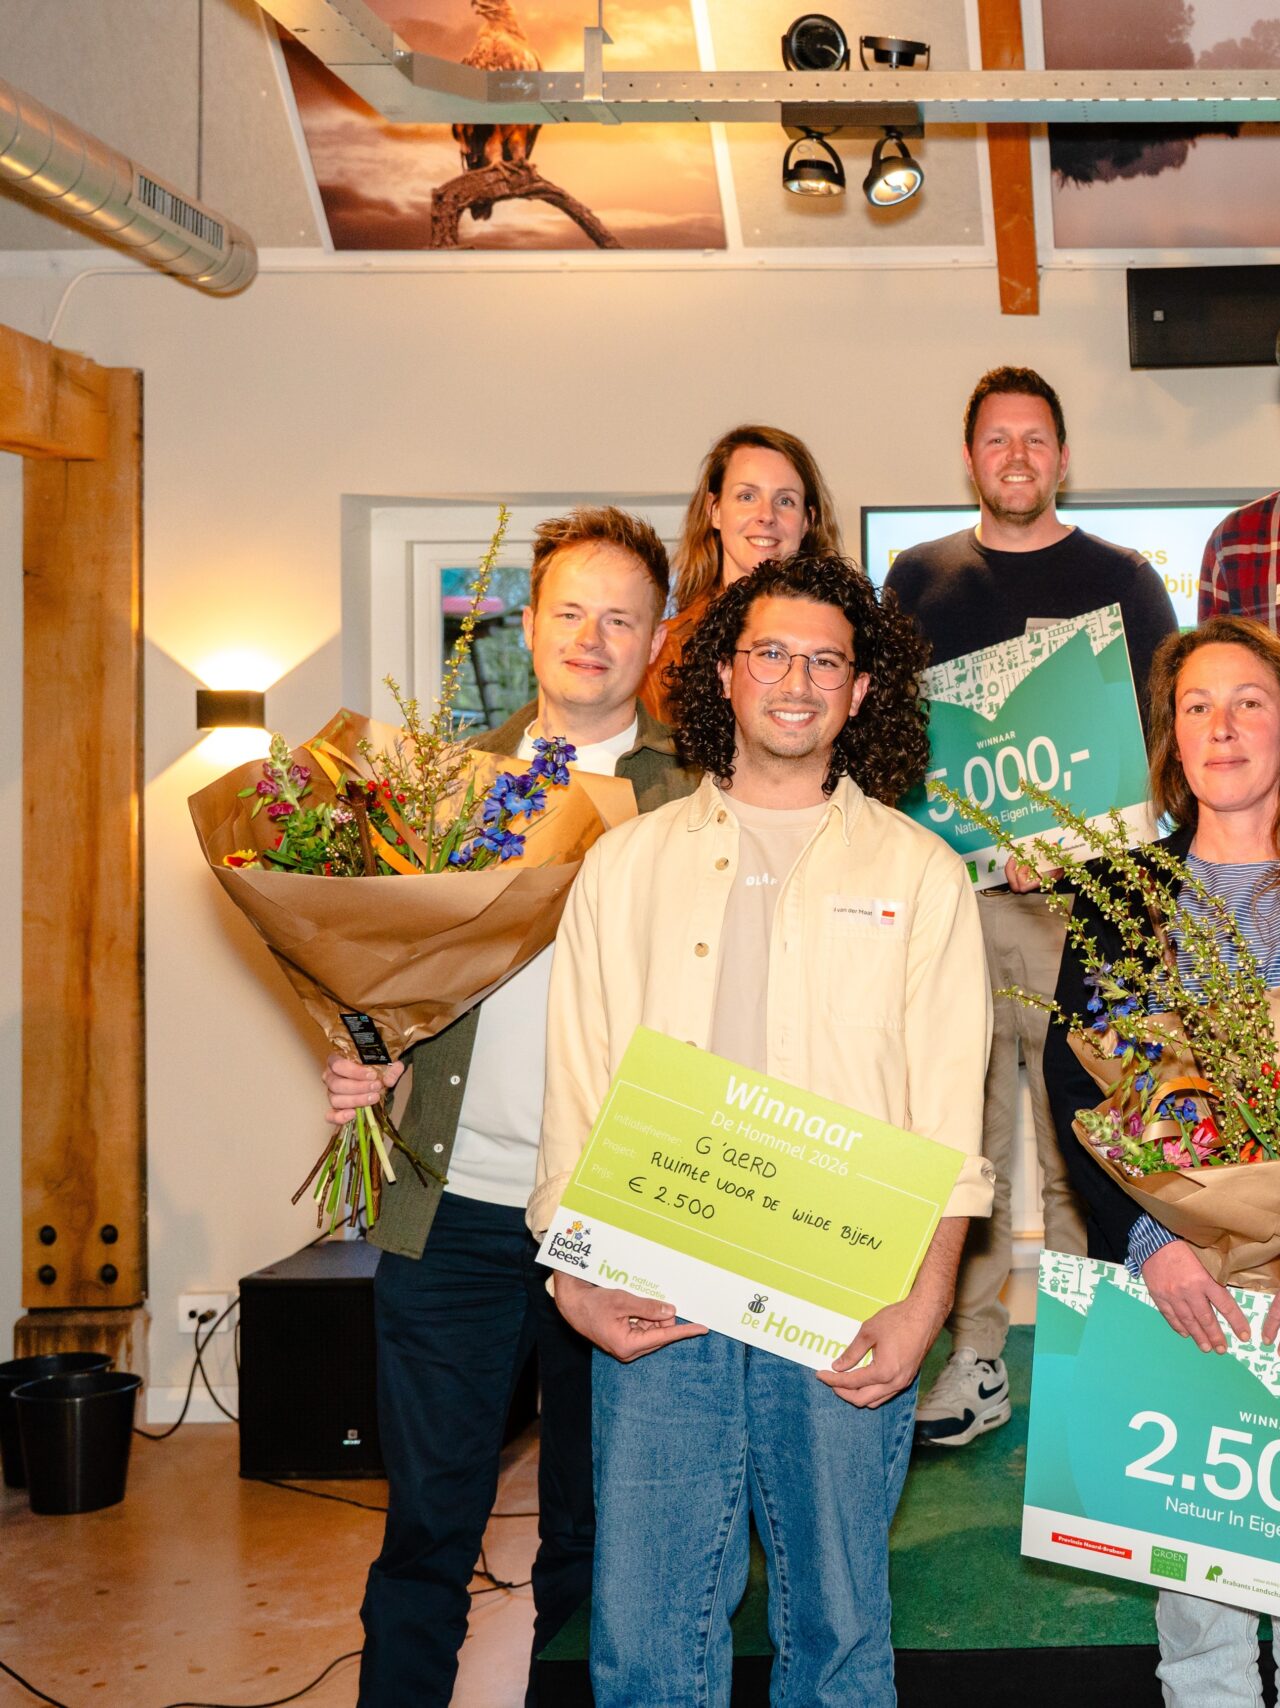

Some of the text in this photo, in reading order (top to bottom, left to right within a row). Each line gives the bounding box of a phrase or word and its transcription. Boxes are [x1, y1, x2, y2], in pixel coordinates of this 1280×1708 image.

[1164, 574, 1200, 599] bij
[976, 730, 1016, 749] WINNAAR
[1001, 806, 1029, 823] Eigen
[725, 1075, 863, 1152] Winnaar
[711, 1111, 849, 1177] De Hommel 2026
[628, 1176, 716, 1220] € 2.500
[762, 1195, 780, 1212] DE
[547, 1244, 581, 1266] bees
[552, 1233, 592, 1257] food4
[598, 1259, 629, 1285] ivn
[629, 1281, 667, 1300] educatie
[631, 1275, 660, 1290] natuur
[740, 1312, 760, 1329] De
[1165, 1496, 1224, 1523] Natuur
[1229, 1510, 1245, 1528] In
[1153, 1549, 1187, 1563] GROEN
[1222, 1578, 1250, 1591] Brabants
